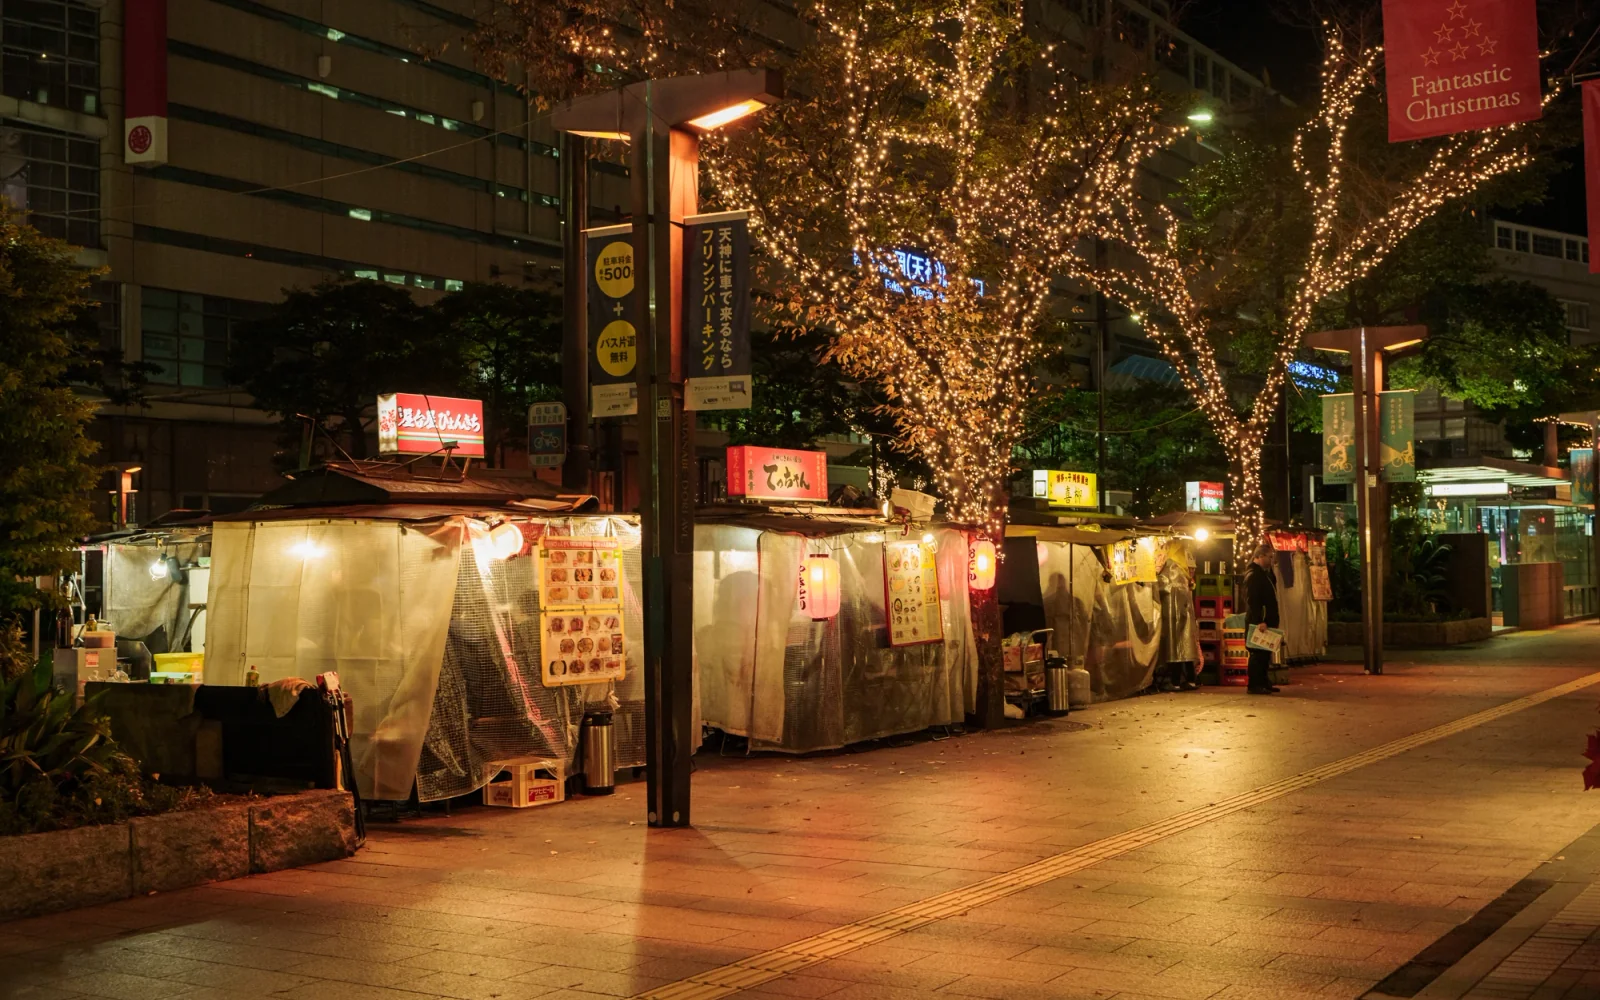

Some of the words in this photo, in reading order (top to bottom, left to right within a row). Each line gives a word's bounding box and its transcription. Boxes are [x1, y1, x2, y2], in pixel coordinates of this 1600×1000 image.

[1411, 64, 1512, 98] Fantastic
[1406, 91, 1521, 122] Christmas
[603, 254, 632, 266] 駐車料金
[702, 229, 715, 371] フリンジパーキング
[718, 227, 733, 369] 天神に車で来るなら
[610, 351, 628, 364] 無料
